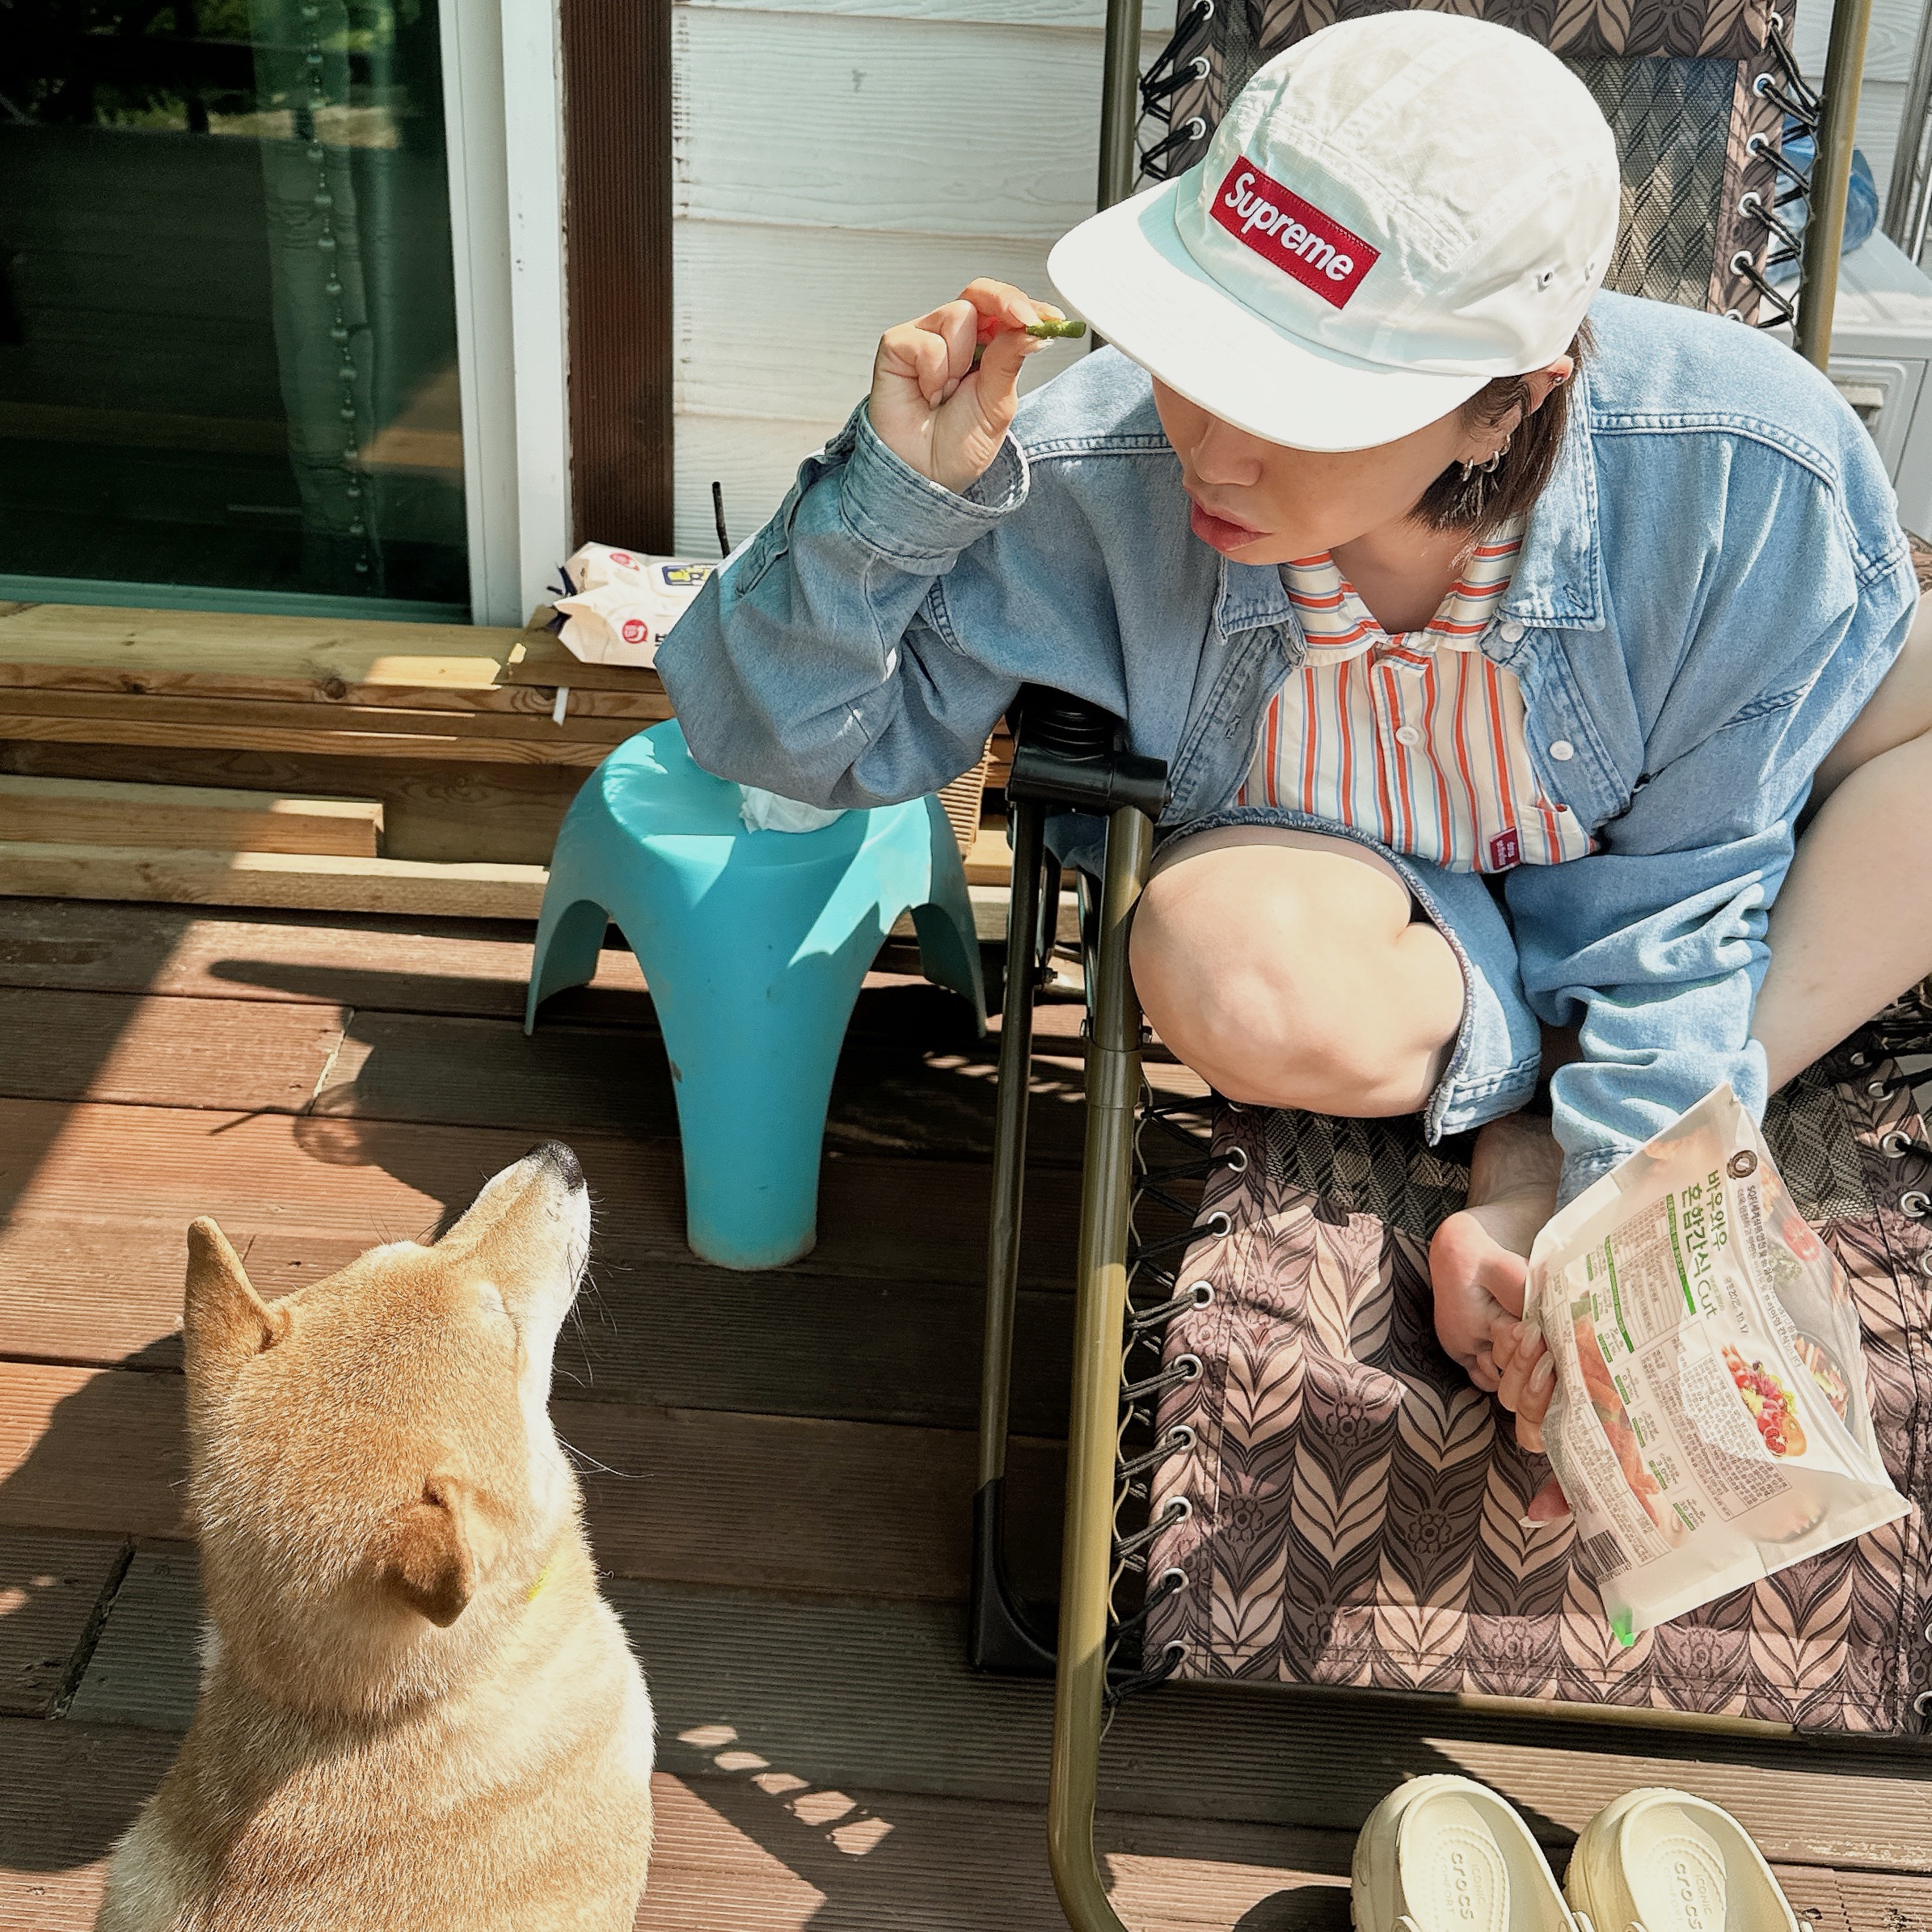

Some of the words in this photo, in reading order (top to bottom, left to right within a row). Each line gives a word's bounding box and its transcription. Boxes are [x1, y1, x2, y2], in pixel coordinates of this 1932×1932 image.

[1224, 171, 1354, 281] Supreme
[1681, 1183, 1711, 1277] 혼합간식
[1697, 1278, 1718, 1319] Cut
[1707, 1170, 1727, 1251] 바우와우
[1451, 1851, 1474, 1920] crocs
[1673, 1861, 1703, 1930] crocs
